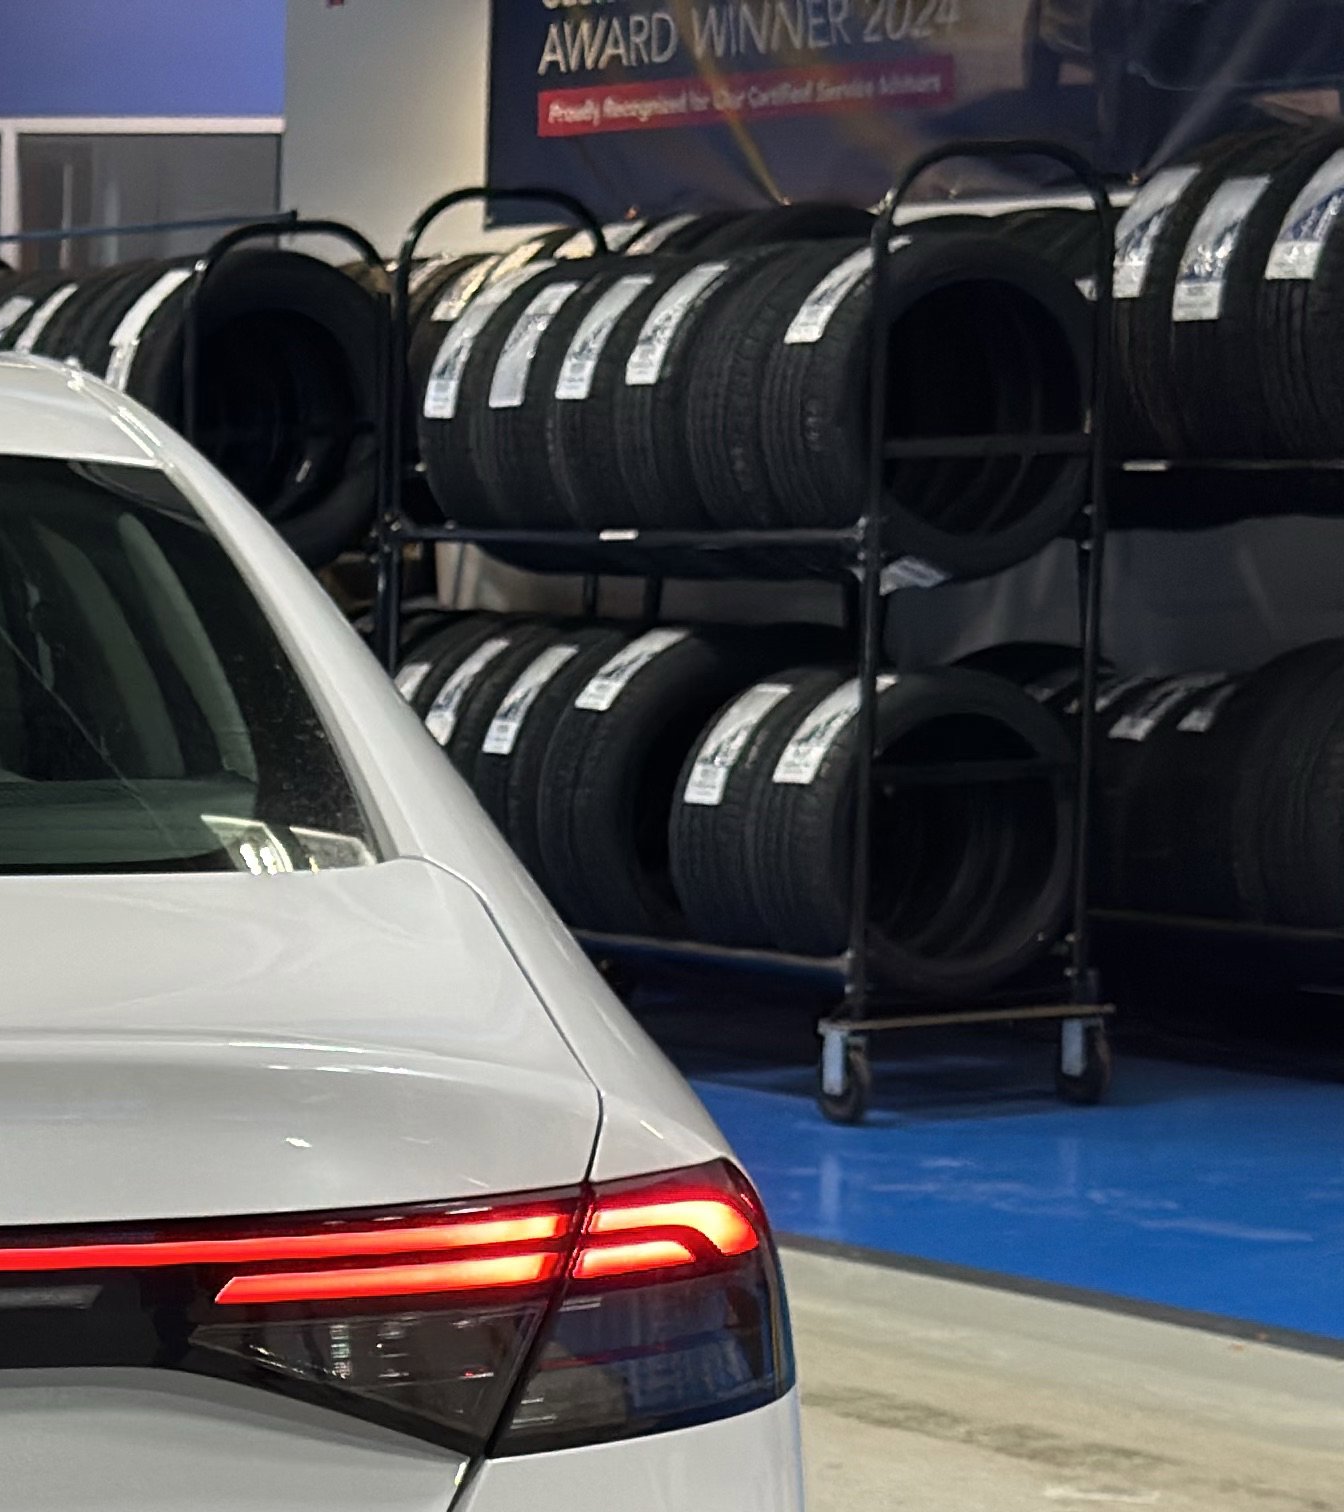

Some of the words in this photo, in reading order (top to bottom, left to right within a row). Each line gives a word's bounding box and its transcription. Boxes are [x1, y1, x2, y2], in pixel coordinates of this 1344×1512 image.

[537, 12, 679, 76] AWARD
[691, 0, 852, 59] WINNER
[862, 0, 961, 42] 2024
